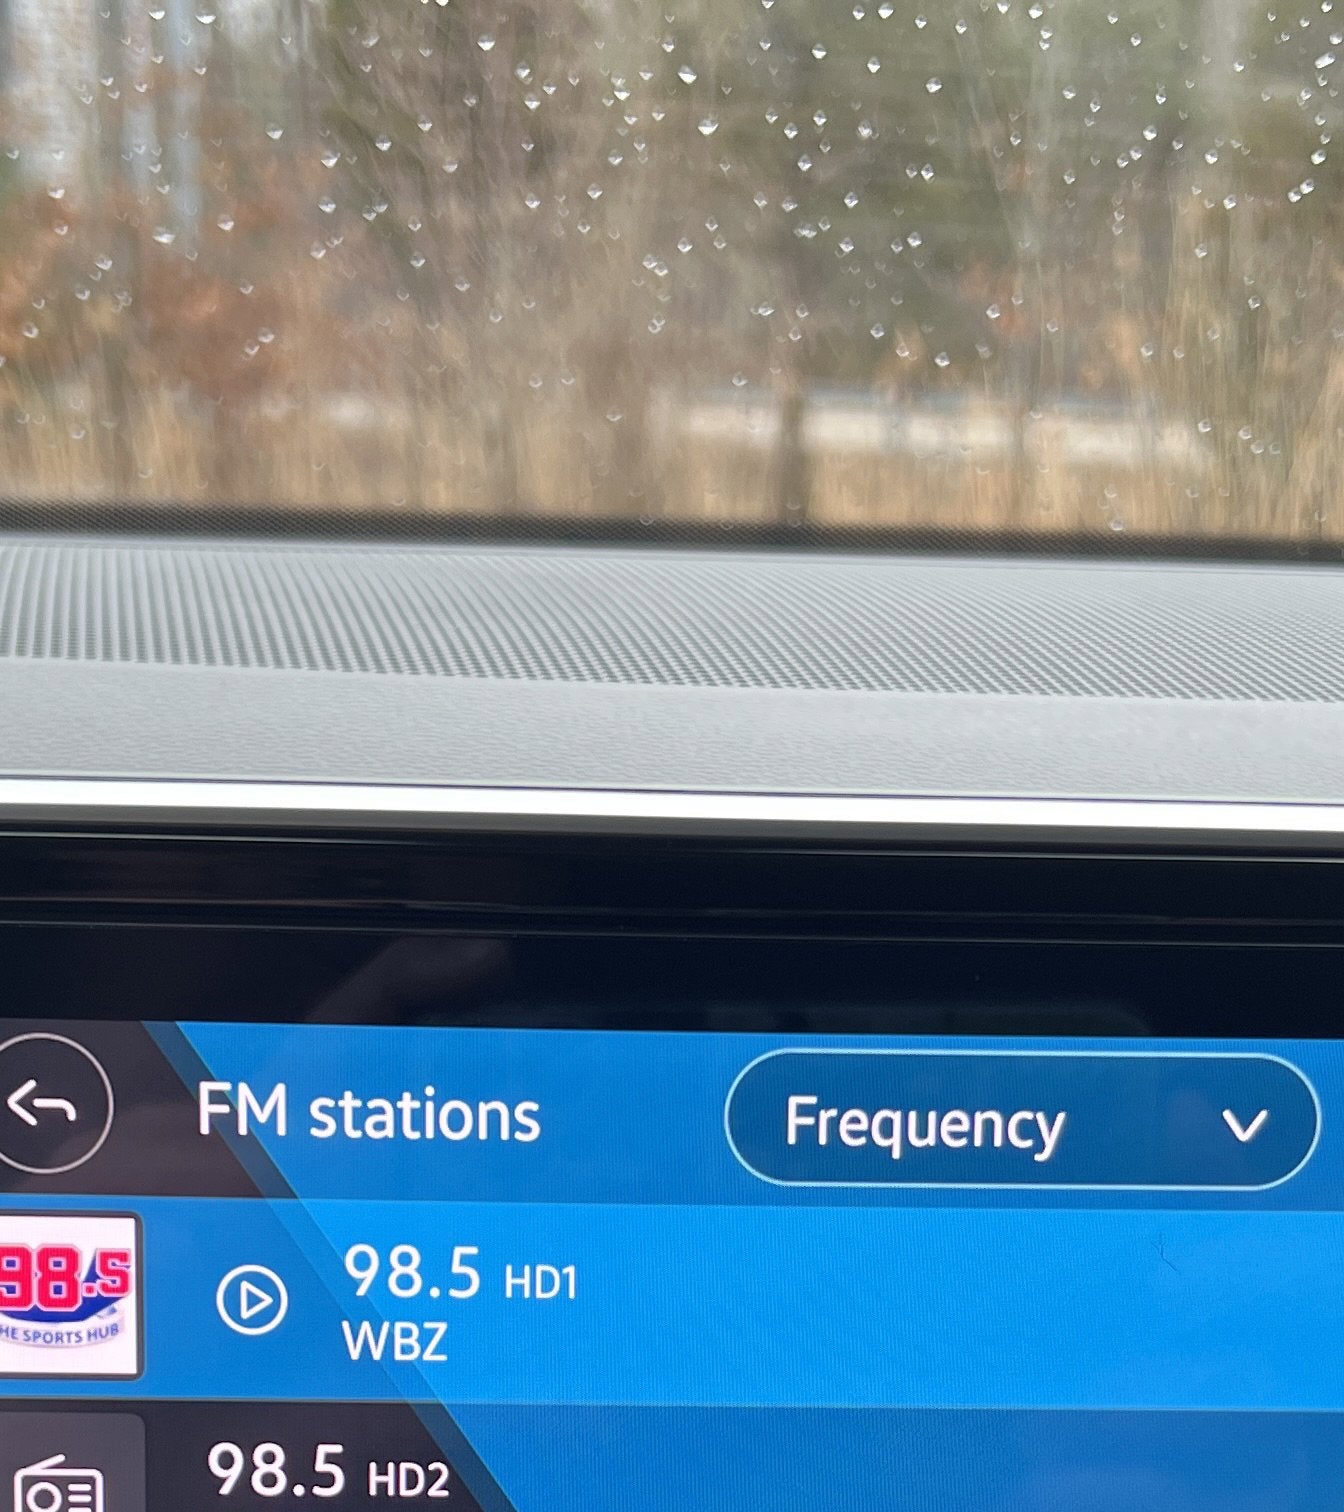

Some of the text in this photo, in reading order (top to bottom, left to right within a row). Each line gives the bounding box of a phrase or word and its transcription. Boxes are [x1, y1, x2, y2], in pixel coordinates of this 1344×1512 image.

[199, 1080, 541, 1142] FM stations
[787, 1095, 1066, 1162] Frequency
[344, 1243, 576, 1300] 98.5 HD1
[23, 1331, 83, 1344] SPORTS
[87, 1323, 120, 1341] HUB
[341, 1320, 448, 1362] WBZ
[207, 1442, 450, 1498] 98.5 HD2
